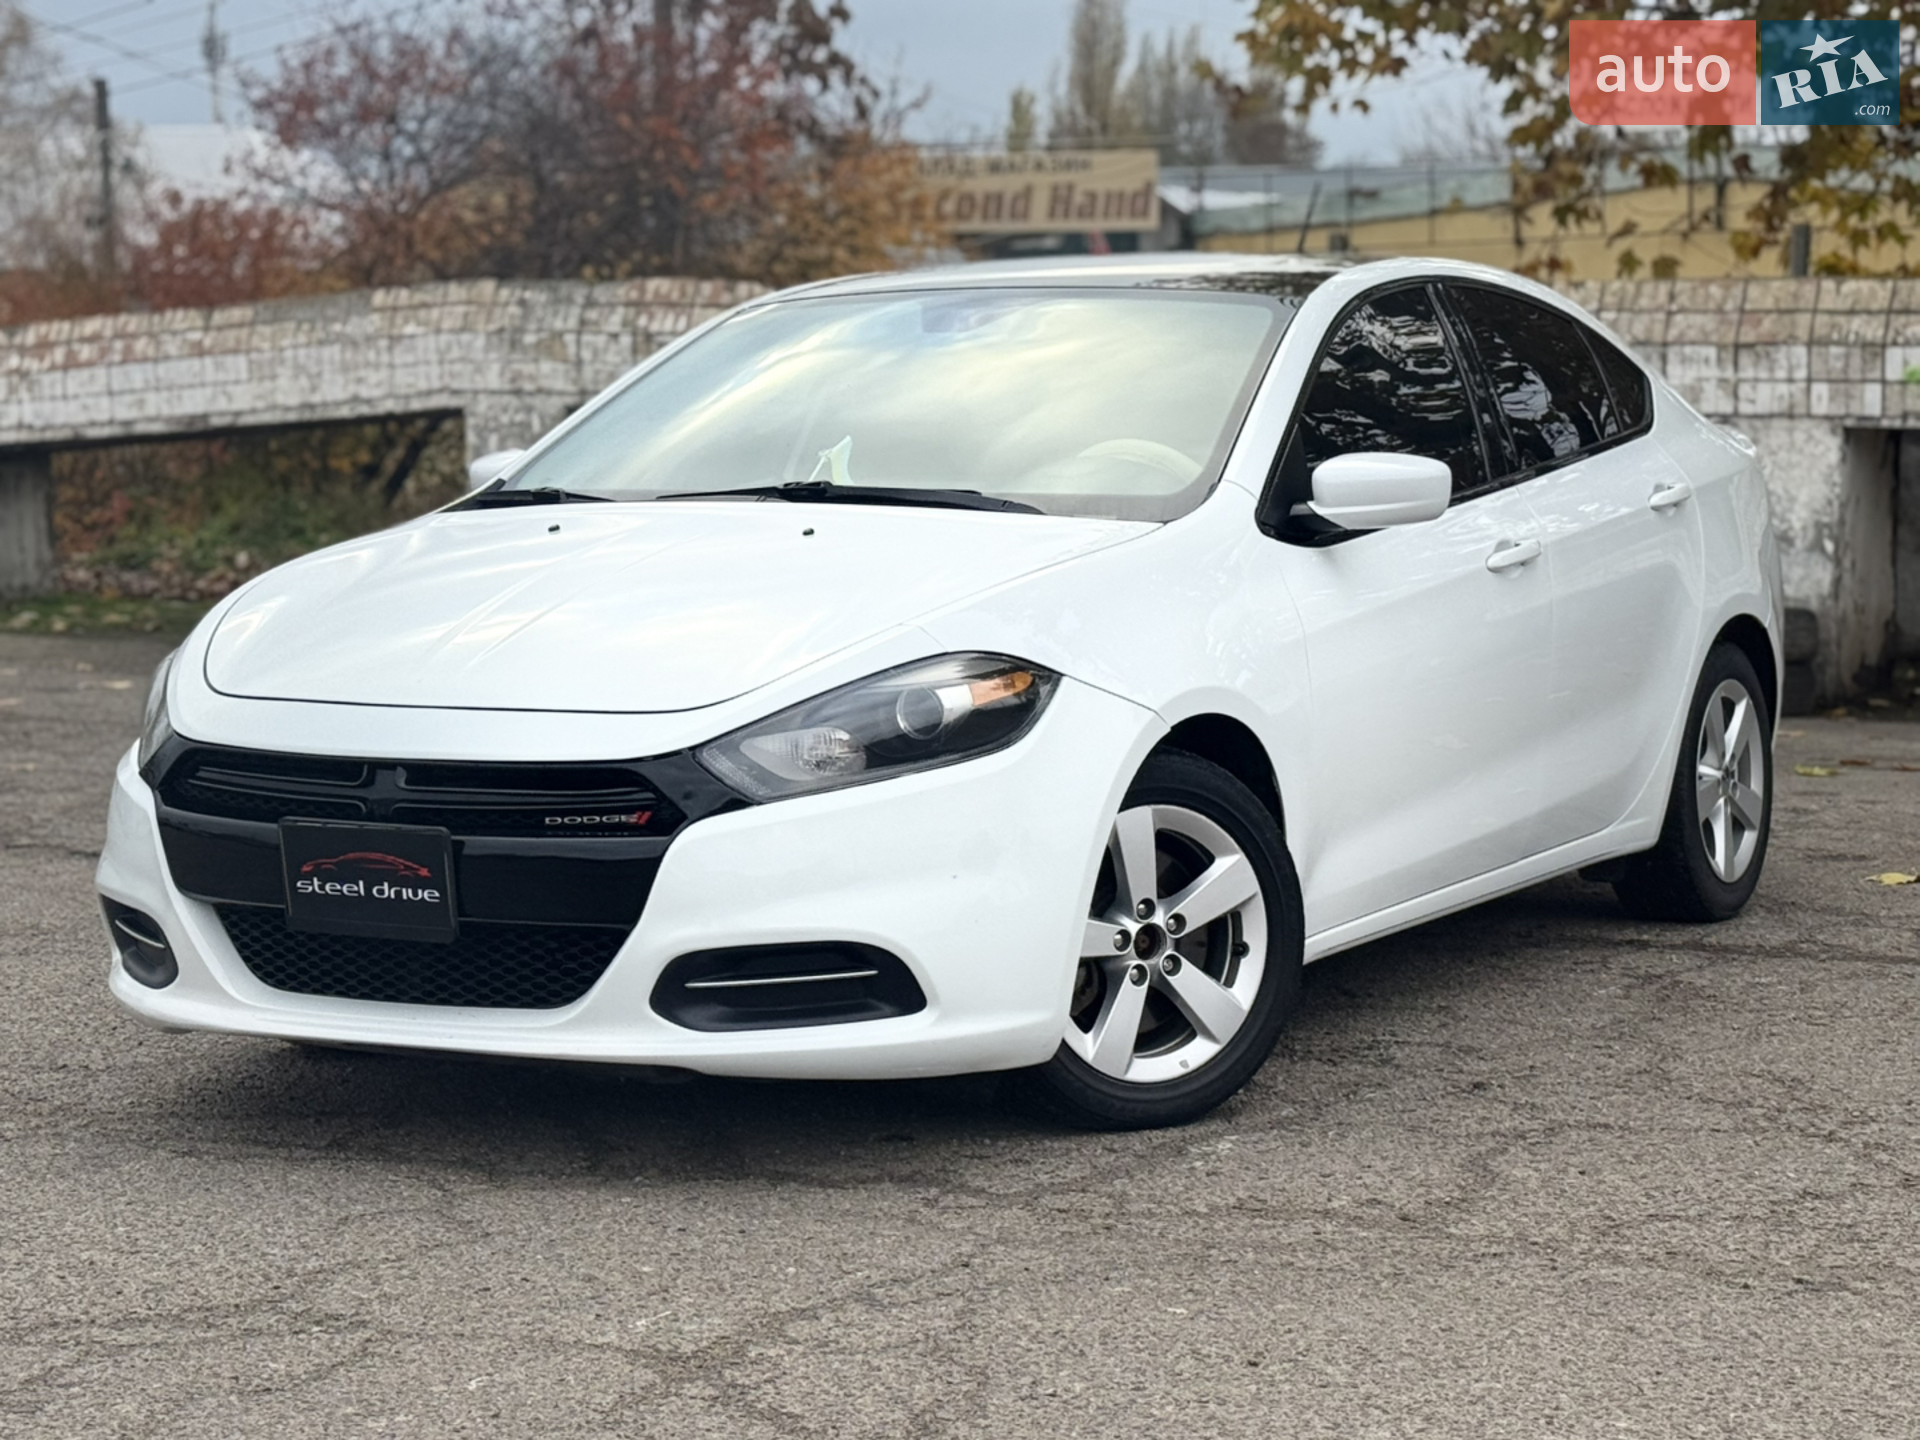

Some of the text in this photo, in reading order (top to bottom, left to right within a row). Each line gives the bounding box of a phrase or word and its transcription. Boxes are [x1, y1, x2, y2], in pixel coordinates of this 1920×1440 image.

[905, 178, 1153, 222] cond Hand
[545, 814, 639, 825] DODGE
[296, 876, 440, 902] steel drive
